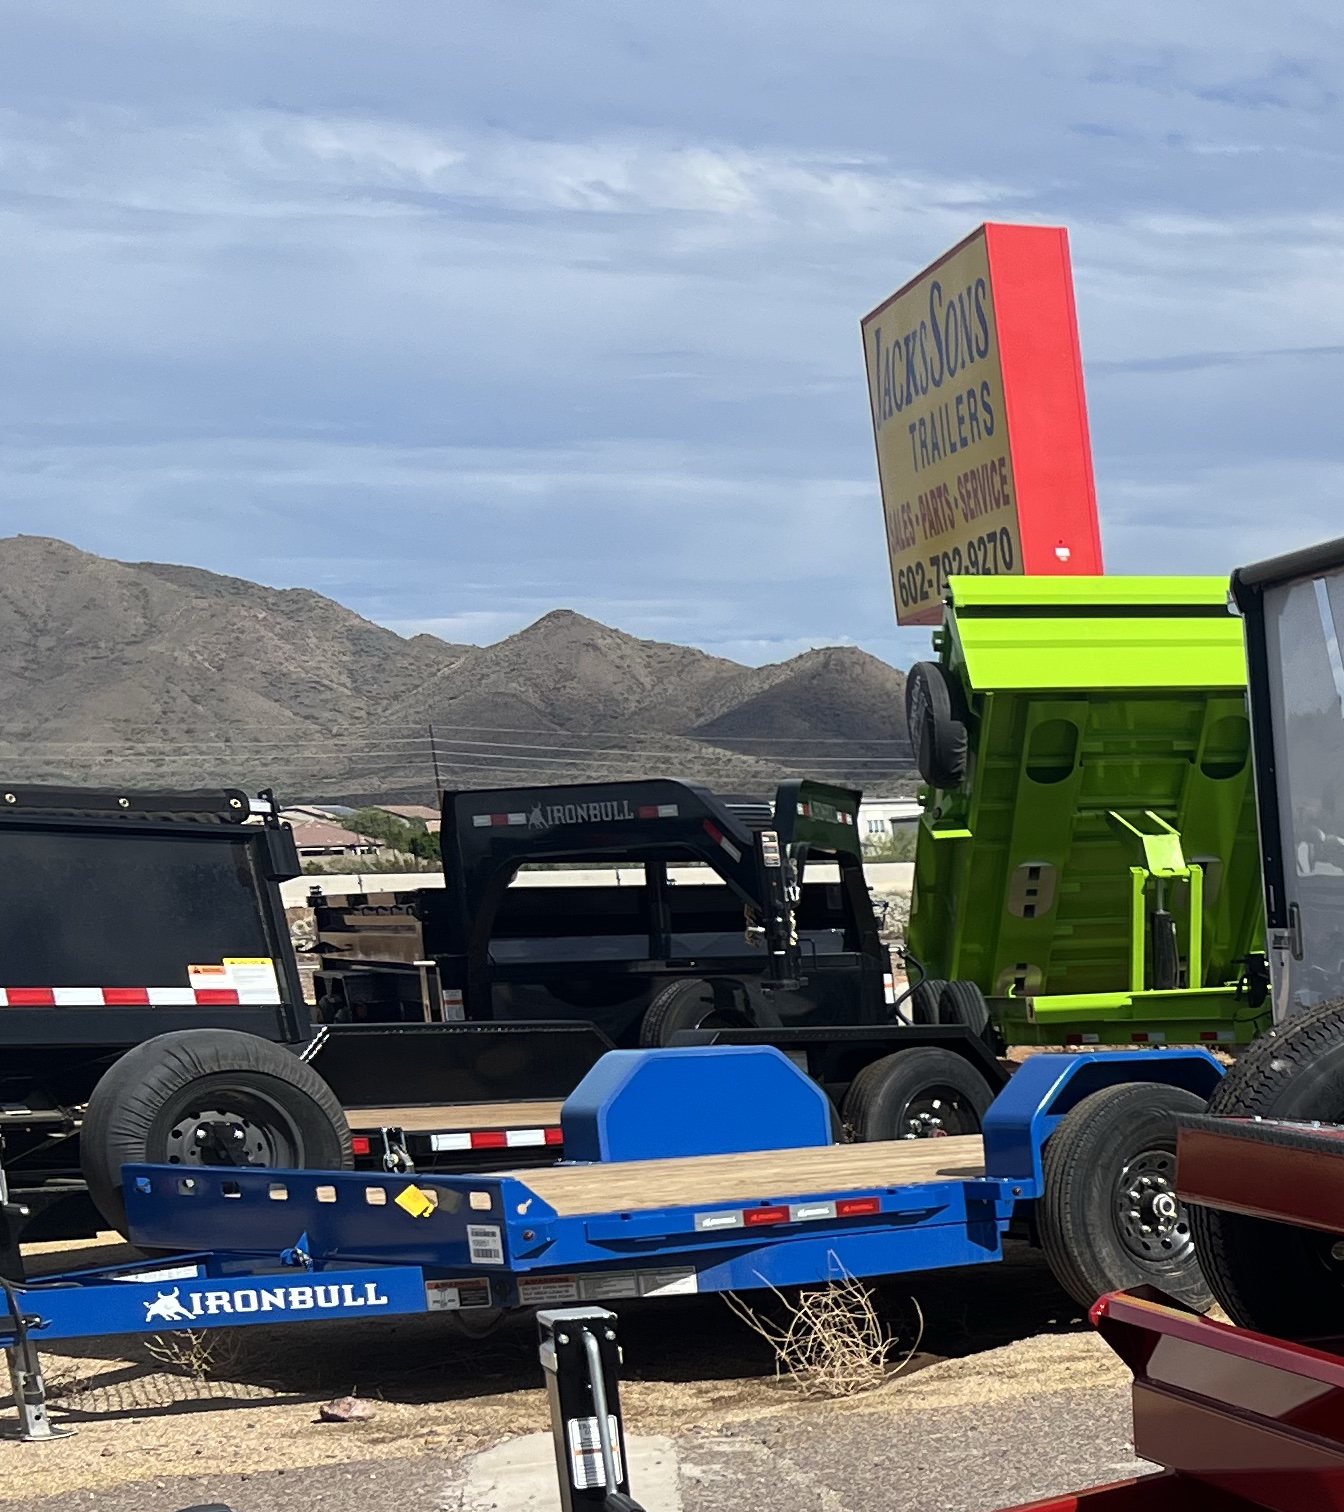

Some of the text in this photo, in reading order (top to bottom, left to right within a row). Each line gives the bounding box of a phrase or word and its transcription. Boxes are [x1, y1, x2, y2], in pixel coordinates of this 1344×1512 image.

[908, 379, 995, 474] TRAILERS
[917, 481, 956, 541] PARTS
[956, 455, 1011, 524] SERVICE
[545, 799, 635, 826] IRONBULL
[189, 1282, 389, 1315] IRONBULL
